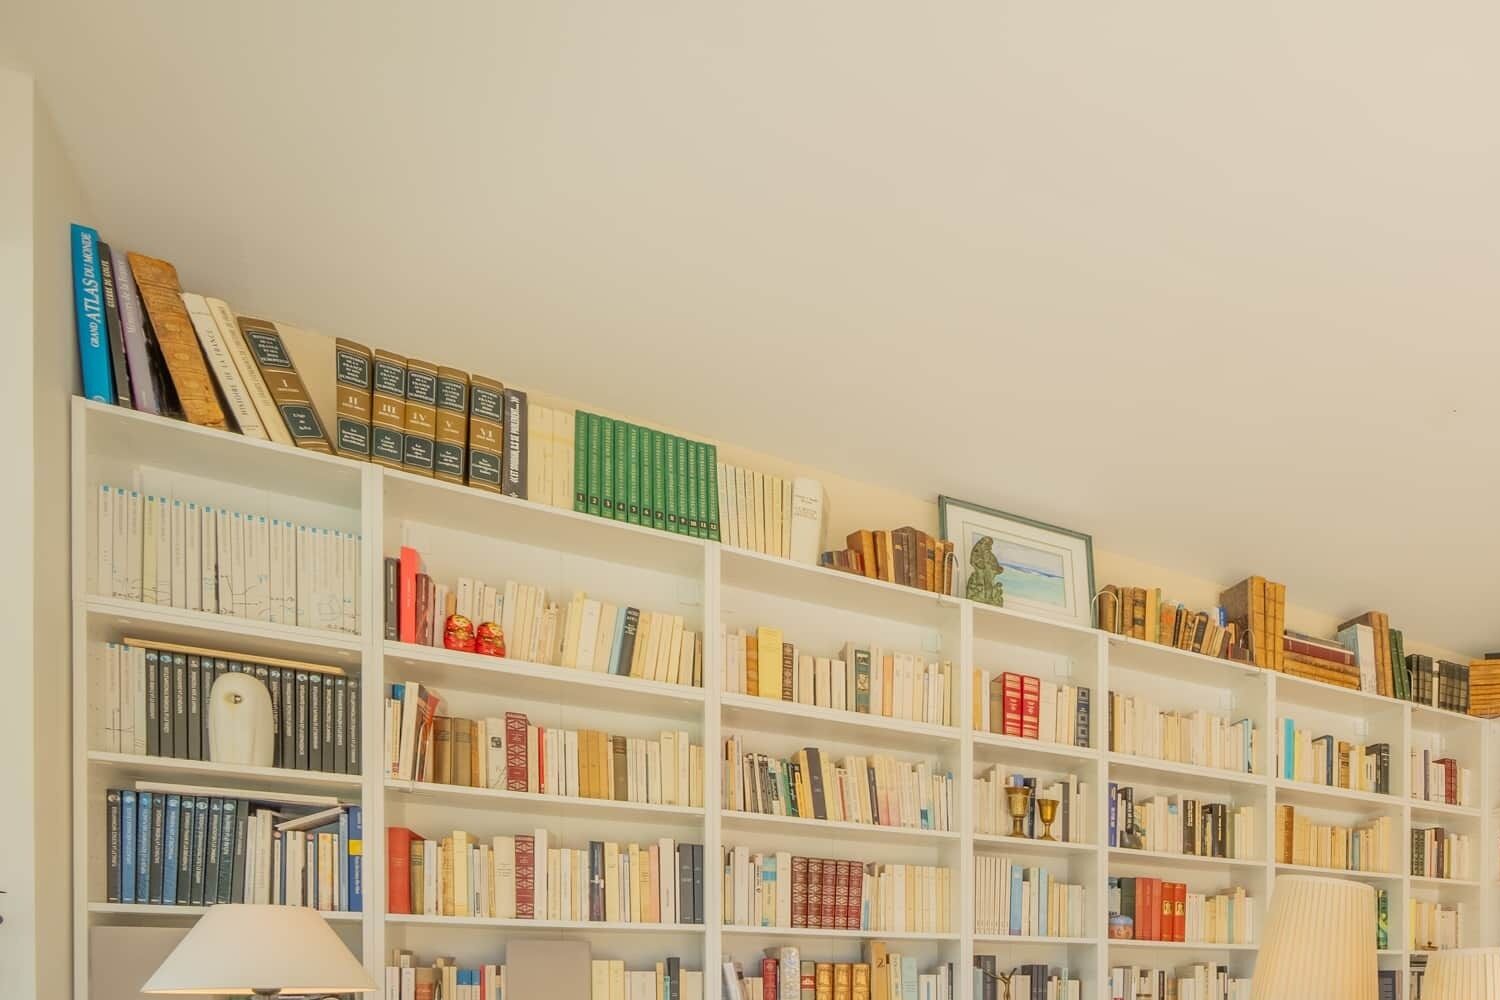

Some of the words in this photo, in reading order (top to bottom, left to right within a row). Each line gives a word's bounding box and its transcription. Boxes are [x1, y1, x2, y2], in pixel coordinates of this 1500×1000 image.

[80, 232, 94, 262] MONDE
[83, 262, 96, 279] DU
[82, 277, 103, 324] ATLAS
[90, 322, 100, 348] GRAND
